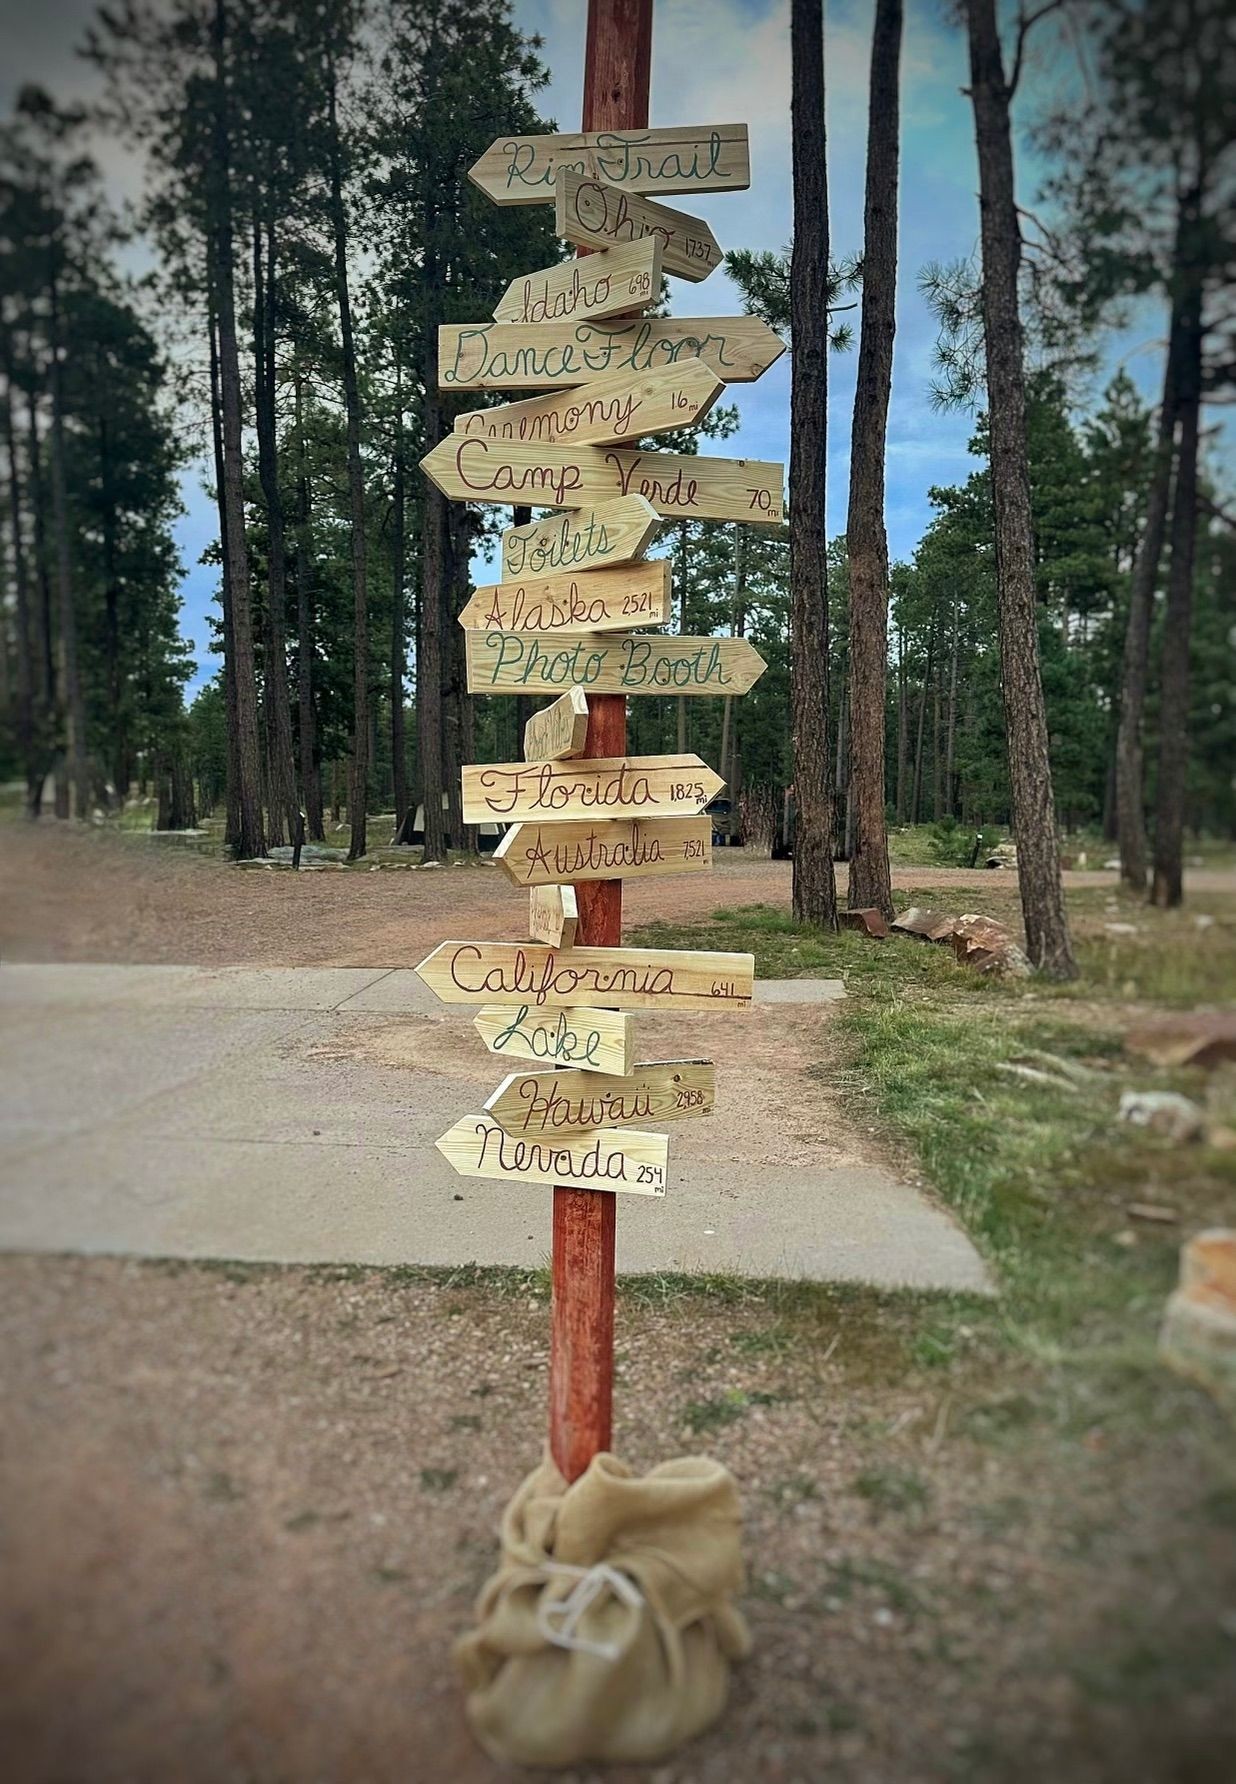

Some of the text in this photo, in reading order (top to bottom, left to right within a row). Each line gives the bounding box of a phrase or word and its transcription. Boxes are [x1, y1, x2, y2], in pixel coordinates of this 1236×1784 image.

[596, 131, 731, 181] Trail
[511, 269, 612, 323] Idaho
[628, 272, 650, 295] 698
[444, 322, 734, 383] Dance Floor
[456, 439, 583, 504] Camp
[605, 453, 699, 506] Verde
[747, 490, 771, 510] 70
[506, 511, 616, 575] Toilets
[484, 582, 612, 631] Alaska
[486, 632, 731, 686] Photo Booth
[480, 763, 659, 813] Florida
[670, 782, 704, 802] 1,825
[525, 823, 665, 879] Australia
[451, 945, 675, 1006] California
[493, 1005, 600, 1067] Lake
[519, 1079, 655, 1131] Hawaii
[475, 1124, 628, 1181] Nevada
[636, 1165, 663, 1184] 254
